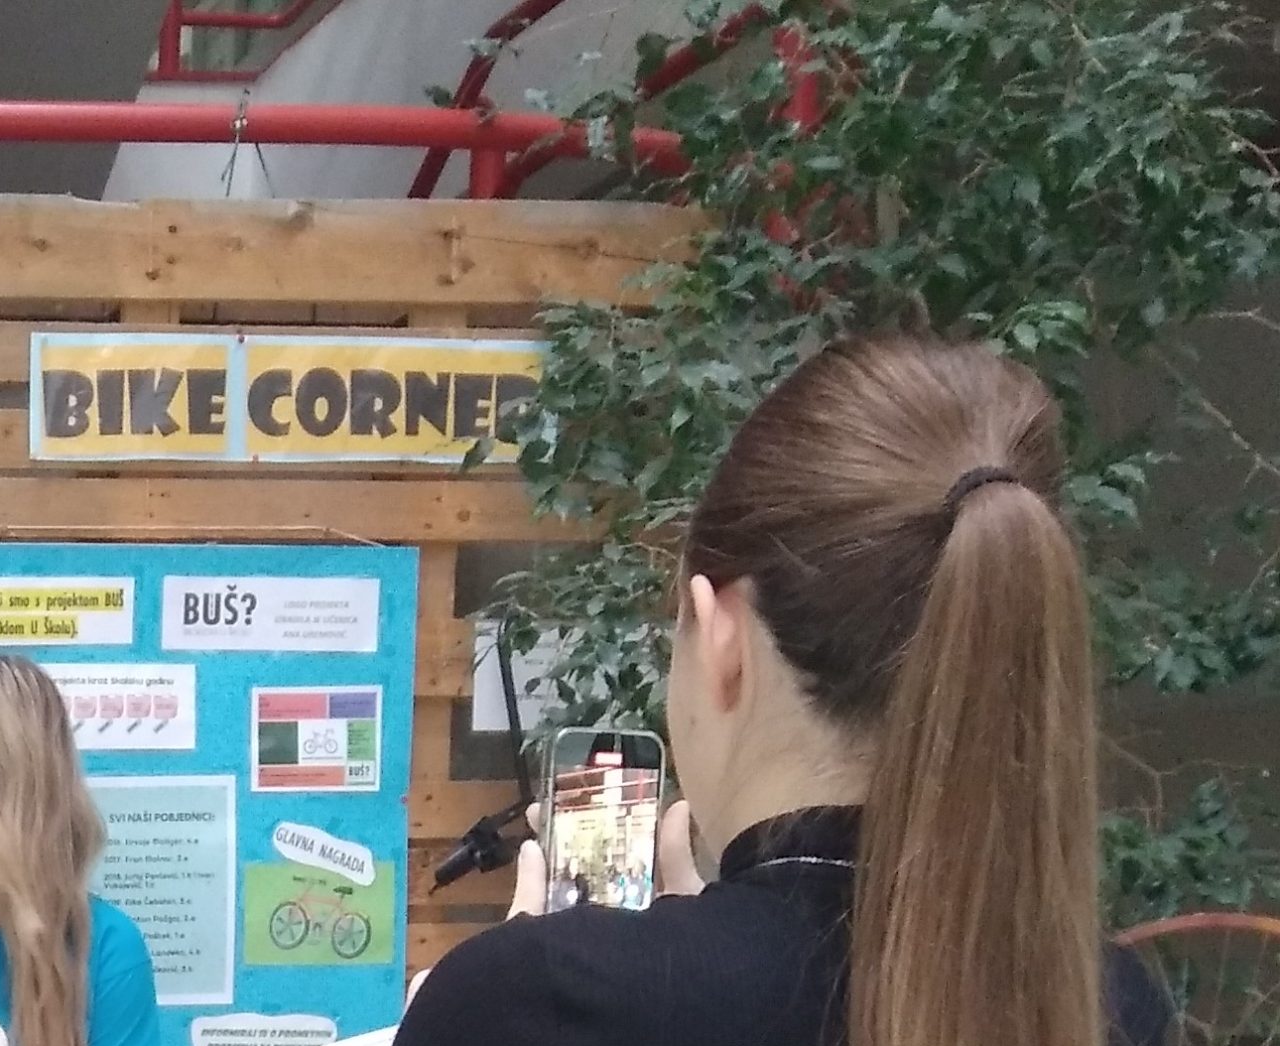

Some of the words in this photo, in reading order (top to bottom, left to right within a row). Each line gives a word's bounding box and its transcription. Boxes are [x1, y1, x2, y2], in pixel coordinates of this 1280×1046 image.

[42, 367, 226, 438] BIKE
[9, 596, 30, 608] smo
[35, 597, 40, 608] s
[46, 592, 99, 610] projektom
[104, 589, 124, 608] BUŠ
[183, 584, 257, 626] BUŠ?
[30, 620, 38, 635] U
[348, 763, 371, 777] BUŠ?
[109, 813, 126, 823] SVI
[127, 811, 152, 822] NAŠI
[154, 812, 216, 822] POBJEDNICI:
[276, 827, 315, 853] GLAVNA
[318, 844, 366, 874] NAGRADA
